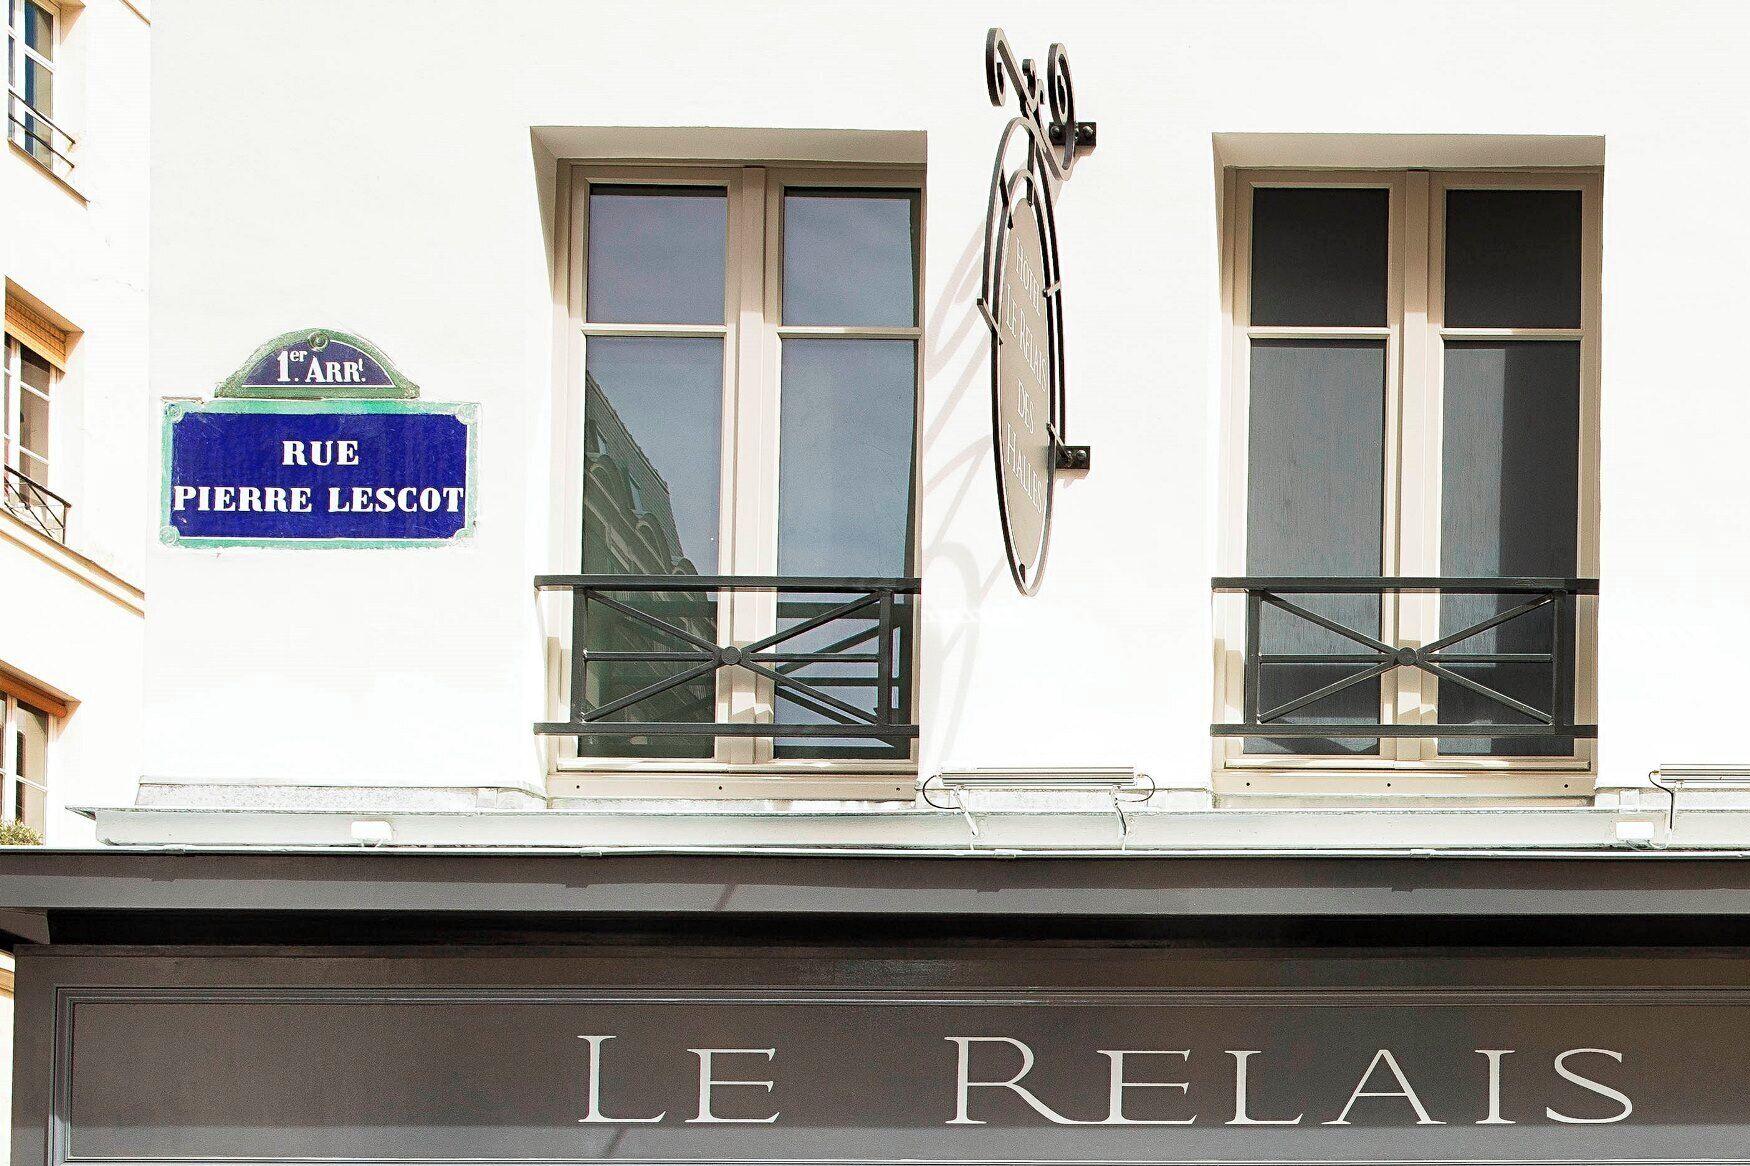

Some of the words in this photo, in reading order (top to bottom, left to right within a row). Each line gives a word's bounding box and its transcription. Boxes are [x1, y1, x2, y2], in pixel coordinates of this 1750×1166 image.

[1006, 283, 1018, 338] LE
[1019, 308, 1046, 393] RELAIS
[1017, 377, 1034, 434] DES
[281, 440, 359, 466] RUE
[1006, 422, 1042, 514] HALLES
[173, 486, 312, 513] PIERRE
[328, 487, 465, 513] LESCOT
[577, 1035, 780, 1124] LE
[943, 1036, 1634, 1125] RELAIS
